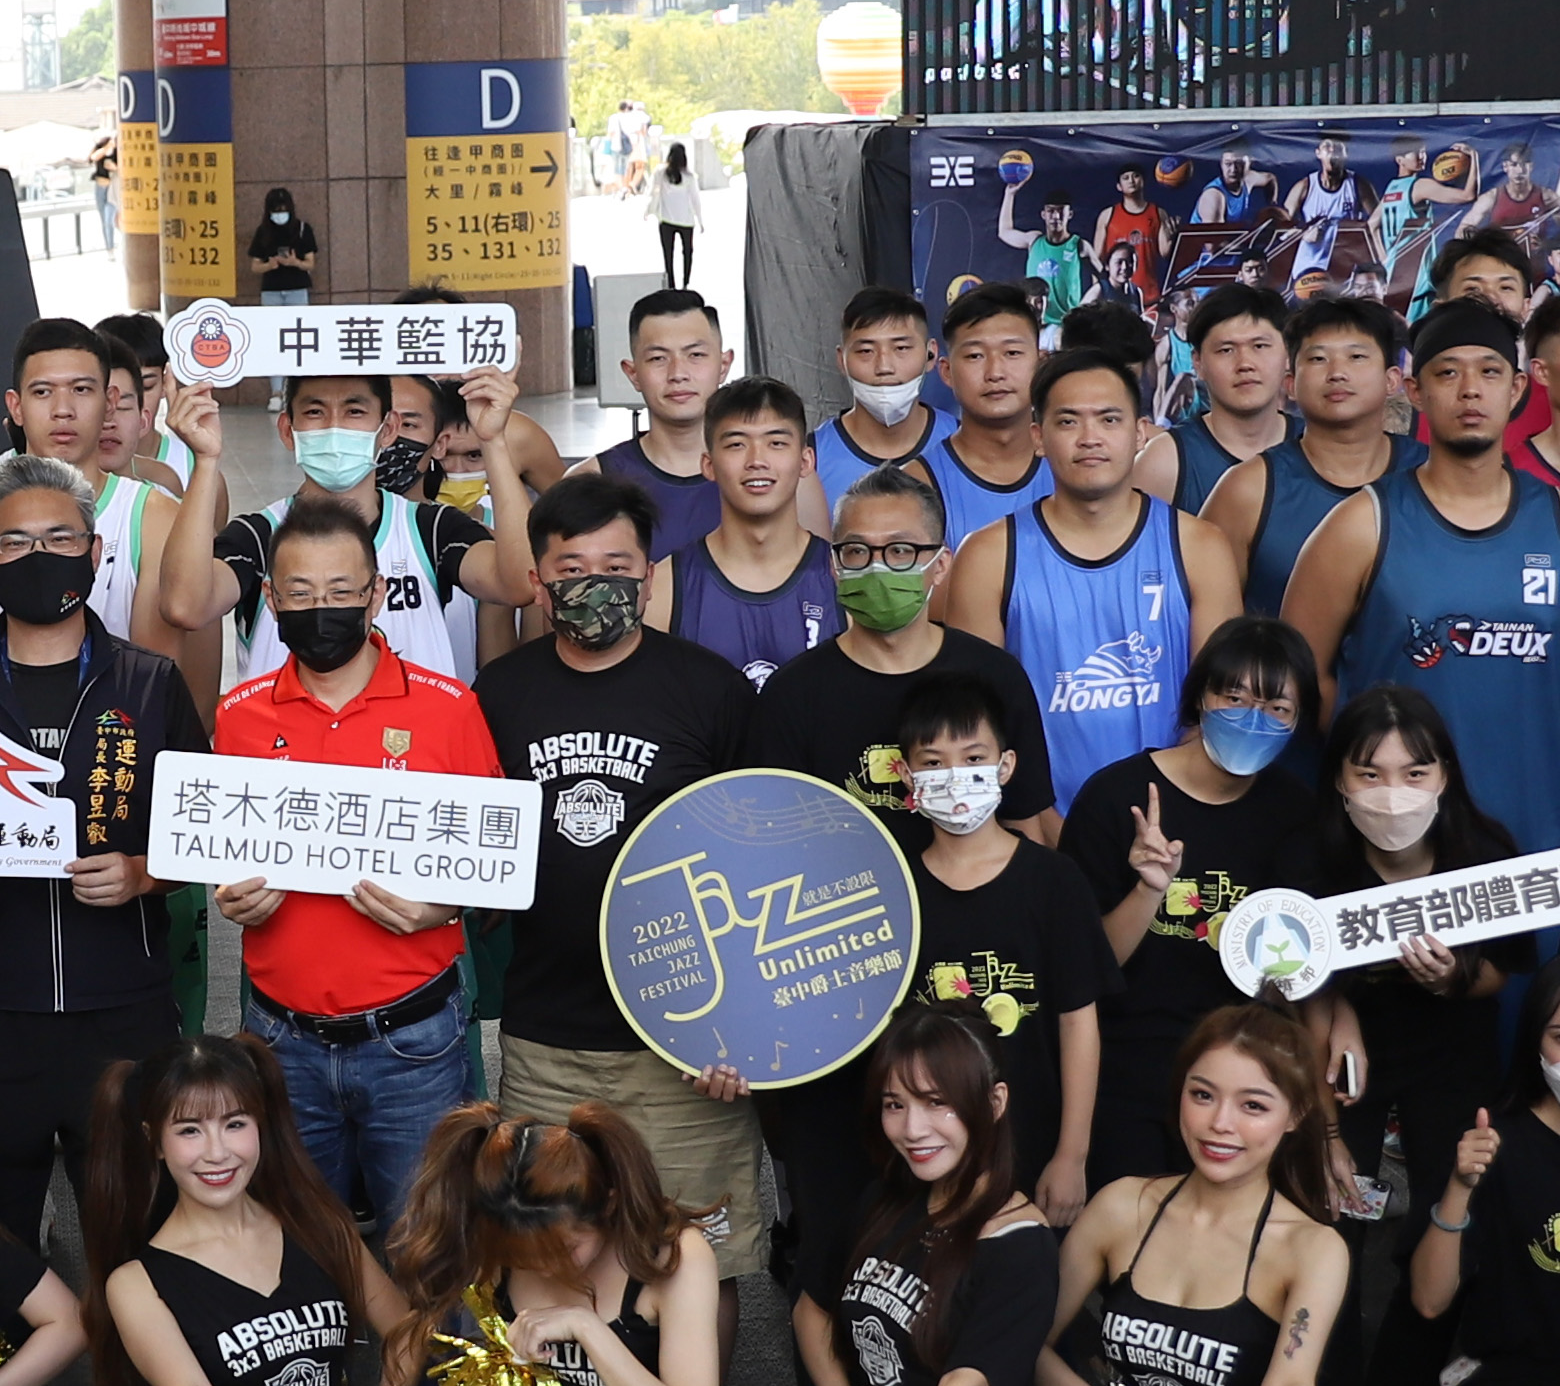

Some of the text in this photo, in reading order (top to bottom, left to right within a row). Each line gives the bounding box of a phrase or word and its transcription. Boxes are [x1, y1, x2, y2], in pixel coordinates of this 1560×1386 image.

[480, 68, 521, 129] D
[278, 314, 508, 368] 中華籃協
[385, 575, 422, 612] 28
[1141, 586, 1164, 622] 7
[1522, 568, 1557, 605] 21
[1471, 632, 1551, 657] DEUX
[1491, 622, 1533, 633] TAINAN
[223, 679, 276, 711] STYLE DE FRANCE
[409, 673, 463, 699] STYLE DE FRANCE
[1048, 681, 1161, 715] HONGYA
[96, 738, 108, 765] 局長
[527, 732, 660, 768] ABSOLUTE
[113, 738, 138, 821] 運動局
[531, 756, 650, 785] 3x3 BASKETBALL
[173, 778, 522, 851] 塔木德酒店集團
[554, 800, 625, 817] ABSOLUTE
[7, 855, 63, 868] Government
[170, 831, 517, 885] TALMUD HOTEL GROUP
[631, 911, 690, 944] 2022
[1230, 899, 1326, 971] MINISTRY OF EDUCATION
[627, 935, 697, 968] TAICHUNG
[666, 951, 702, 977] JAZZ
[757, 921, 895, 983] Unlimited
[638, 971, 707, 1003] FESTIVAL
[771, 949, 904, 1009] 臺中爵士音樂節
[216, 1298, 349, 1363] ABSOLUTE
[1102, 1311, 1239, 1374] ABSOLUTE
[227, 1325, 348, 1379] 3x3 BASKETBALL
